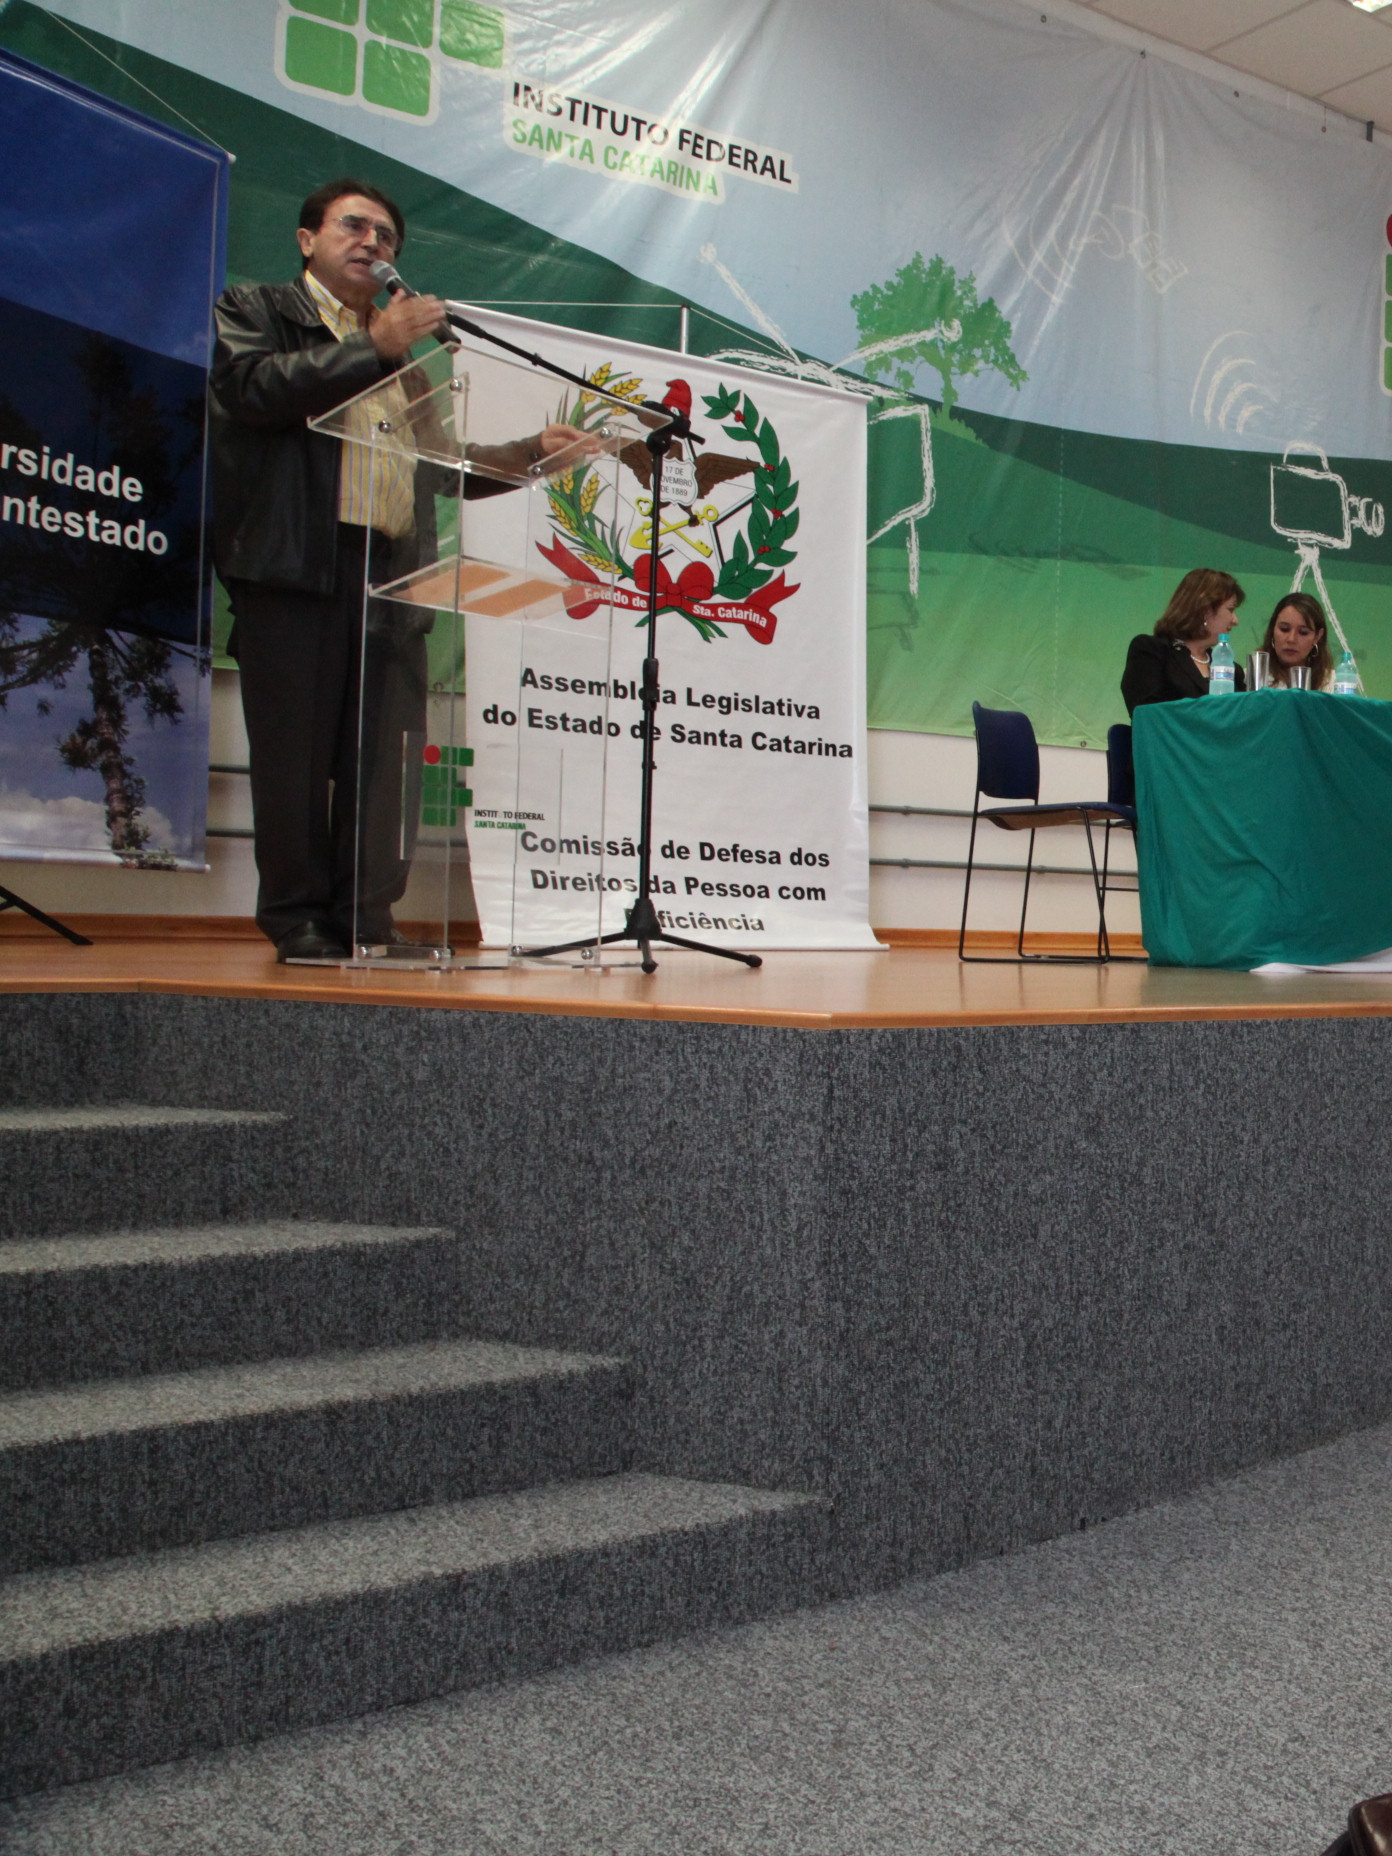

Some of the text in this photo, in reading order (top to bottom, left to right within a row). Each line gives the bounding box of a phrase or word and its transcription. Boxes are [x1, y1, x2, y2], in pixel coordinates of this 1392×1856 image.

[512, 81, 792, 184] INSTITUTO FEDERAL
[512, 118, 718, 196] SANTA CATARINA
[0, 443, 144, 503] rsidade
[661, 475, 692, 487] OVEMBRO
[665, 466, 684, 476] 17 DE
[661, 485, 688, 496] DE 1889
[2, 495, 168, 555] ntestado
[631, 596, 648, 608] de
[692, 604, 714, 617] Sta.
[717, 607, 767, 627] Catarina
[521, 668, 820, 720] Assemblia Legislativa
[482, 704, 853, 758] do Estado de Santa Catarina
[474, 809, 545, 821] INSTITTO FEDERAL
[474, 820, 496, 829] SANTA
[660, 840, 691, 860] de
[699, 841, 782, 866] Defesa
[789, 848, 830, 867] dos
[530, 869, 827, 901] Direitos da Pessoa com
[624, 908, 765, 932] ficiência
